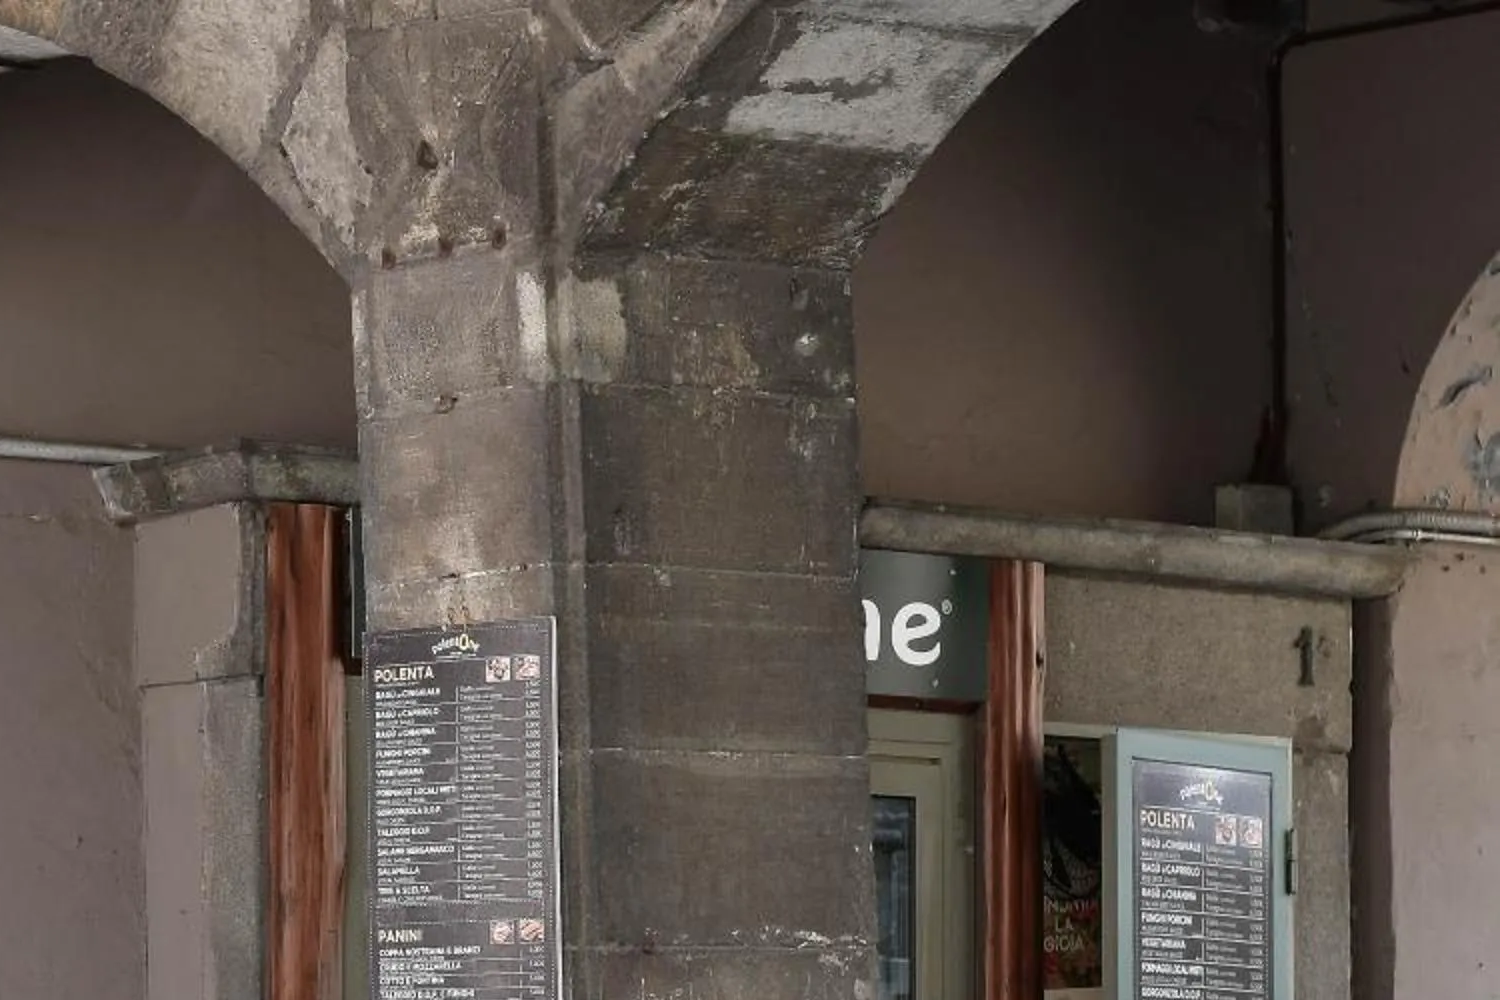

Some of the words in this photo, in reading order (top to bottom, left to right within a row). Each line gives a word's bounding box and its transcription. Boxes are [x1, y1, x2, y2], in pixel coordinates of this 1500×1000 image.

[374, 665, 435, 683] POLENTA
[1140, 809, 1196, 830] POLENTA
[377, 929, 423, 943] PANINI
